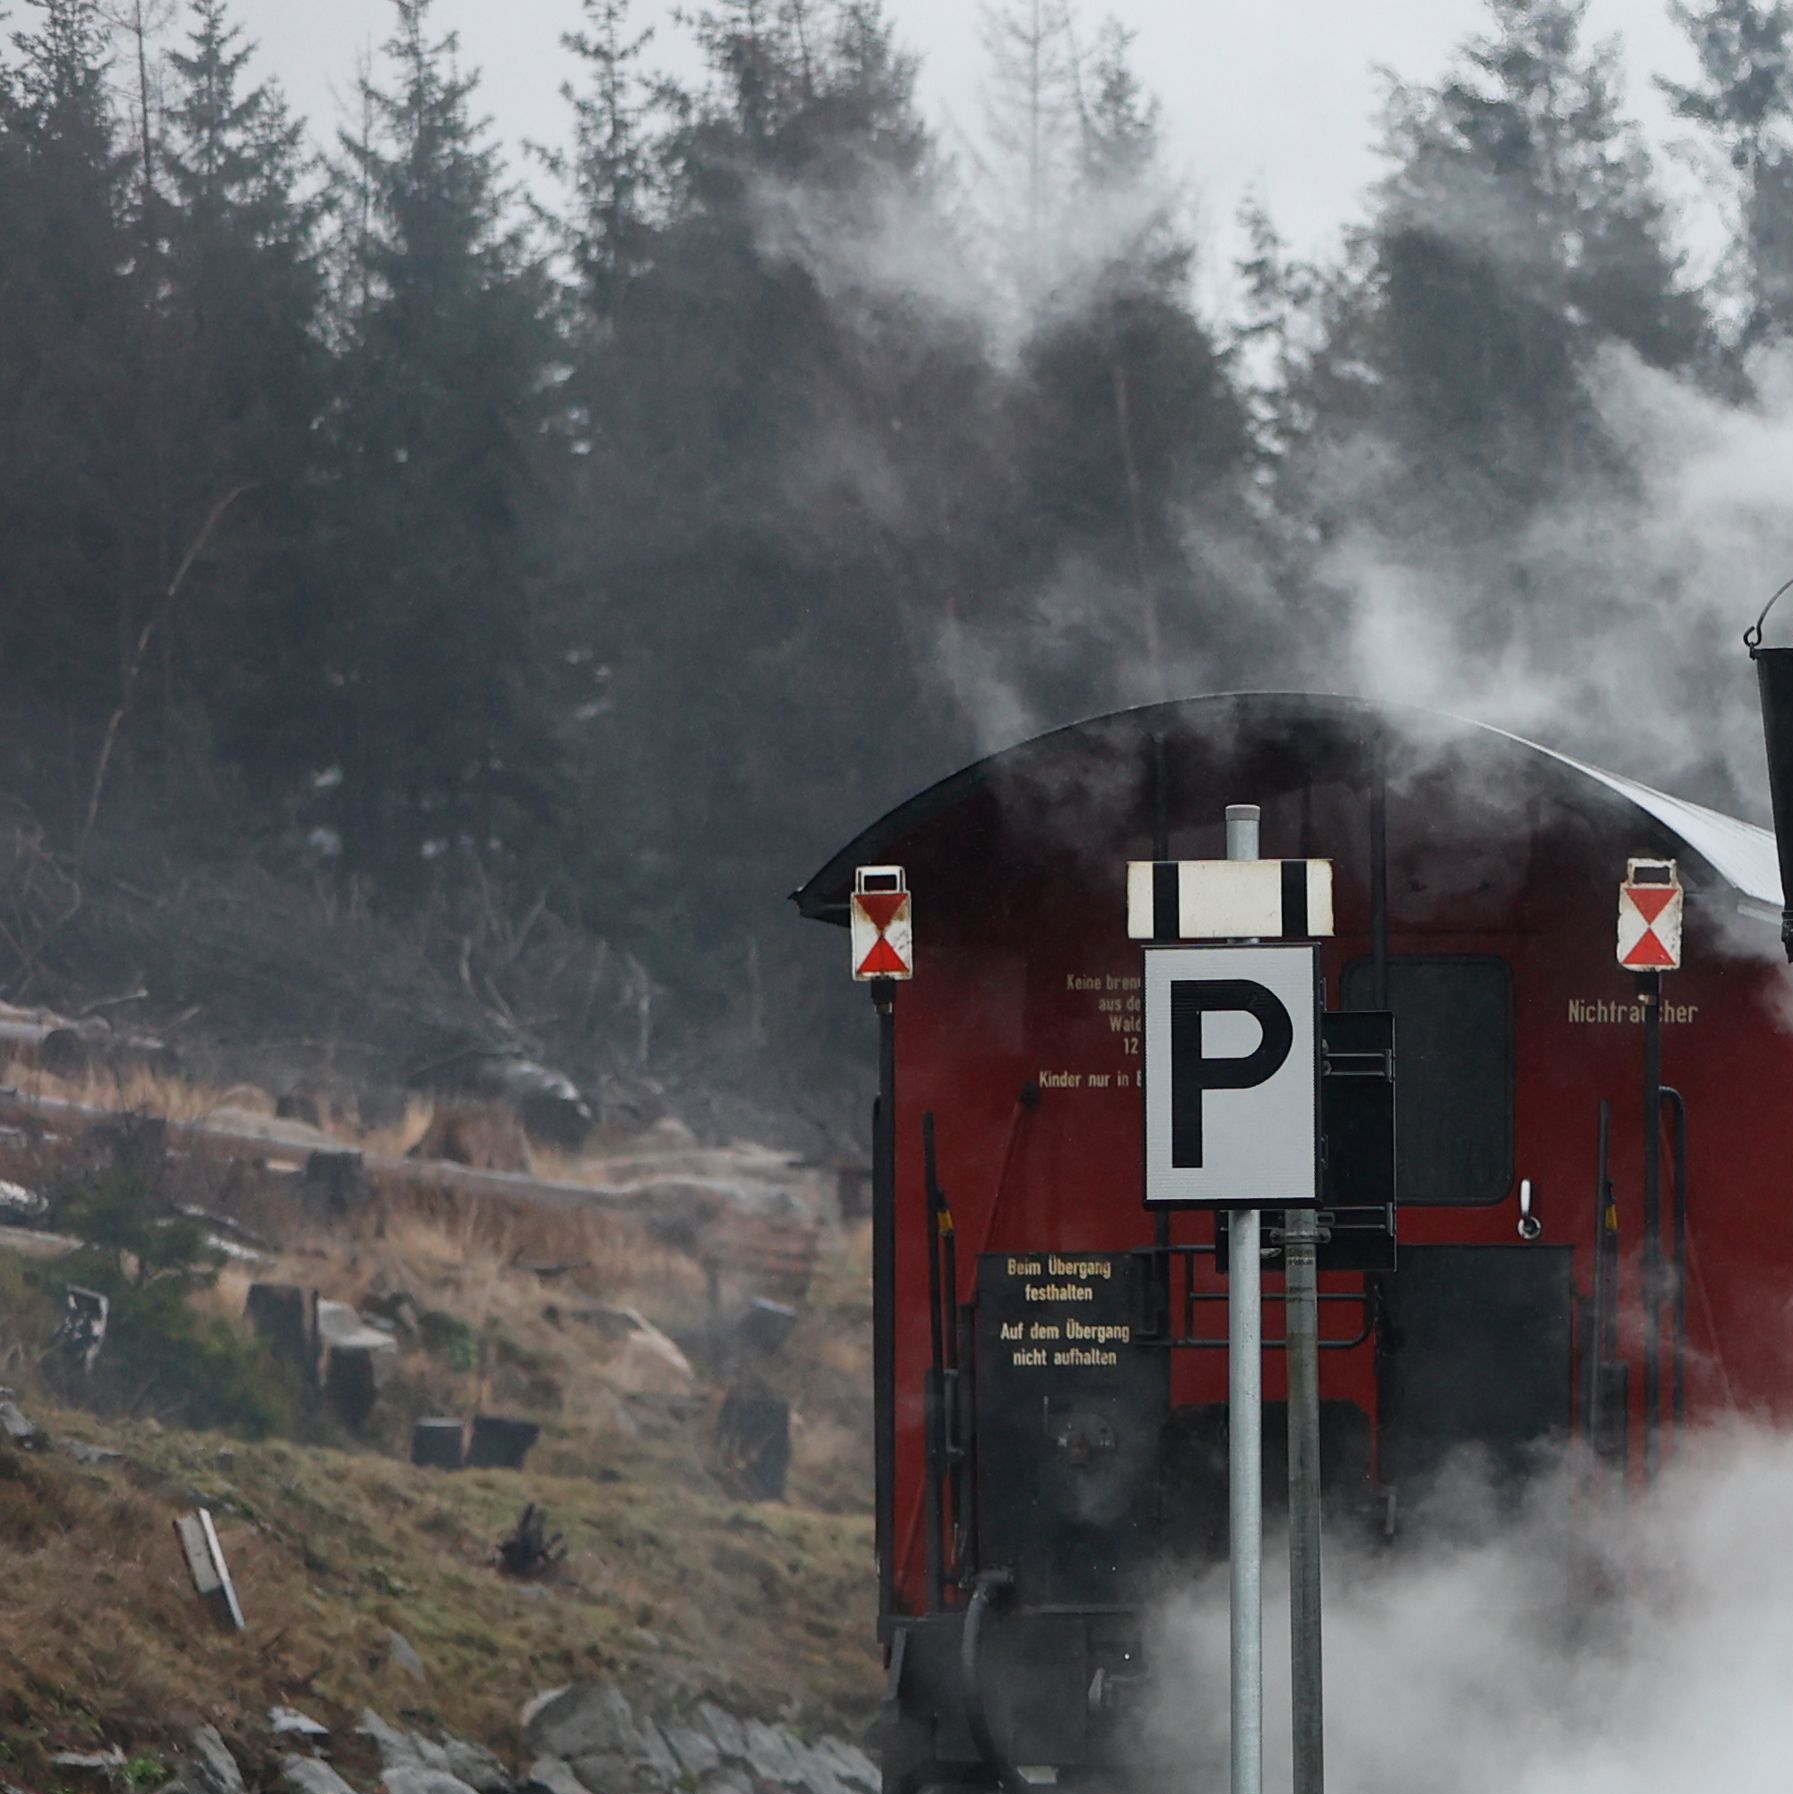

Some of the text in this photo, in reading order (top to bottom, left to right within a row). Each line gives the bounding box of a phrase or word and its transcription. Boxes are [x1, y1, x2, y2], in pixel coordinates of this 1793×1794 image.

[1066, 974, 1101, 990] Keine
[1099, 998, 1121, 1012] aus
[1568, 999, 1698, 1023] Nichtraher
[1039, 1071, 1081, 1088] Kinder
[1088, 1073, 1111, 1088] nur
[1117, 1071, 1130, 1087] in
[1170, 979, 1293, 1168] P
[1007, 1254, 1112, 1280] Beim Übergang
[1025, 1283, 1094, 1301] festhalten
[1000, 1318, 1130, 1344] Auf dem Übergang
[1013, 1348, 1118, 1366] nicht aufhalten
